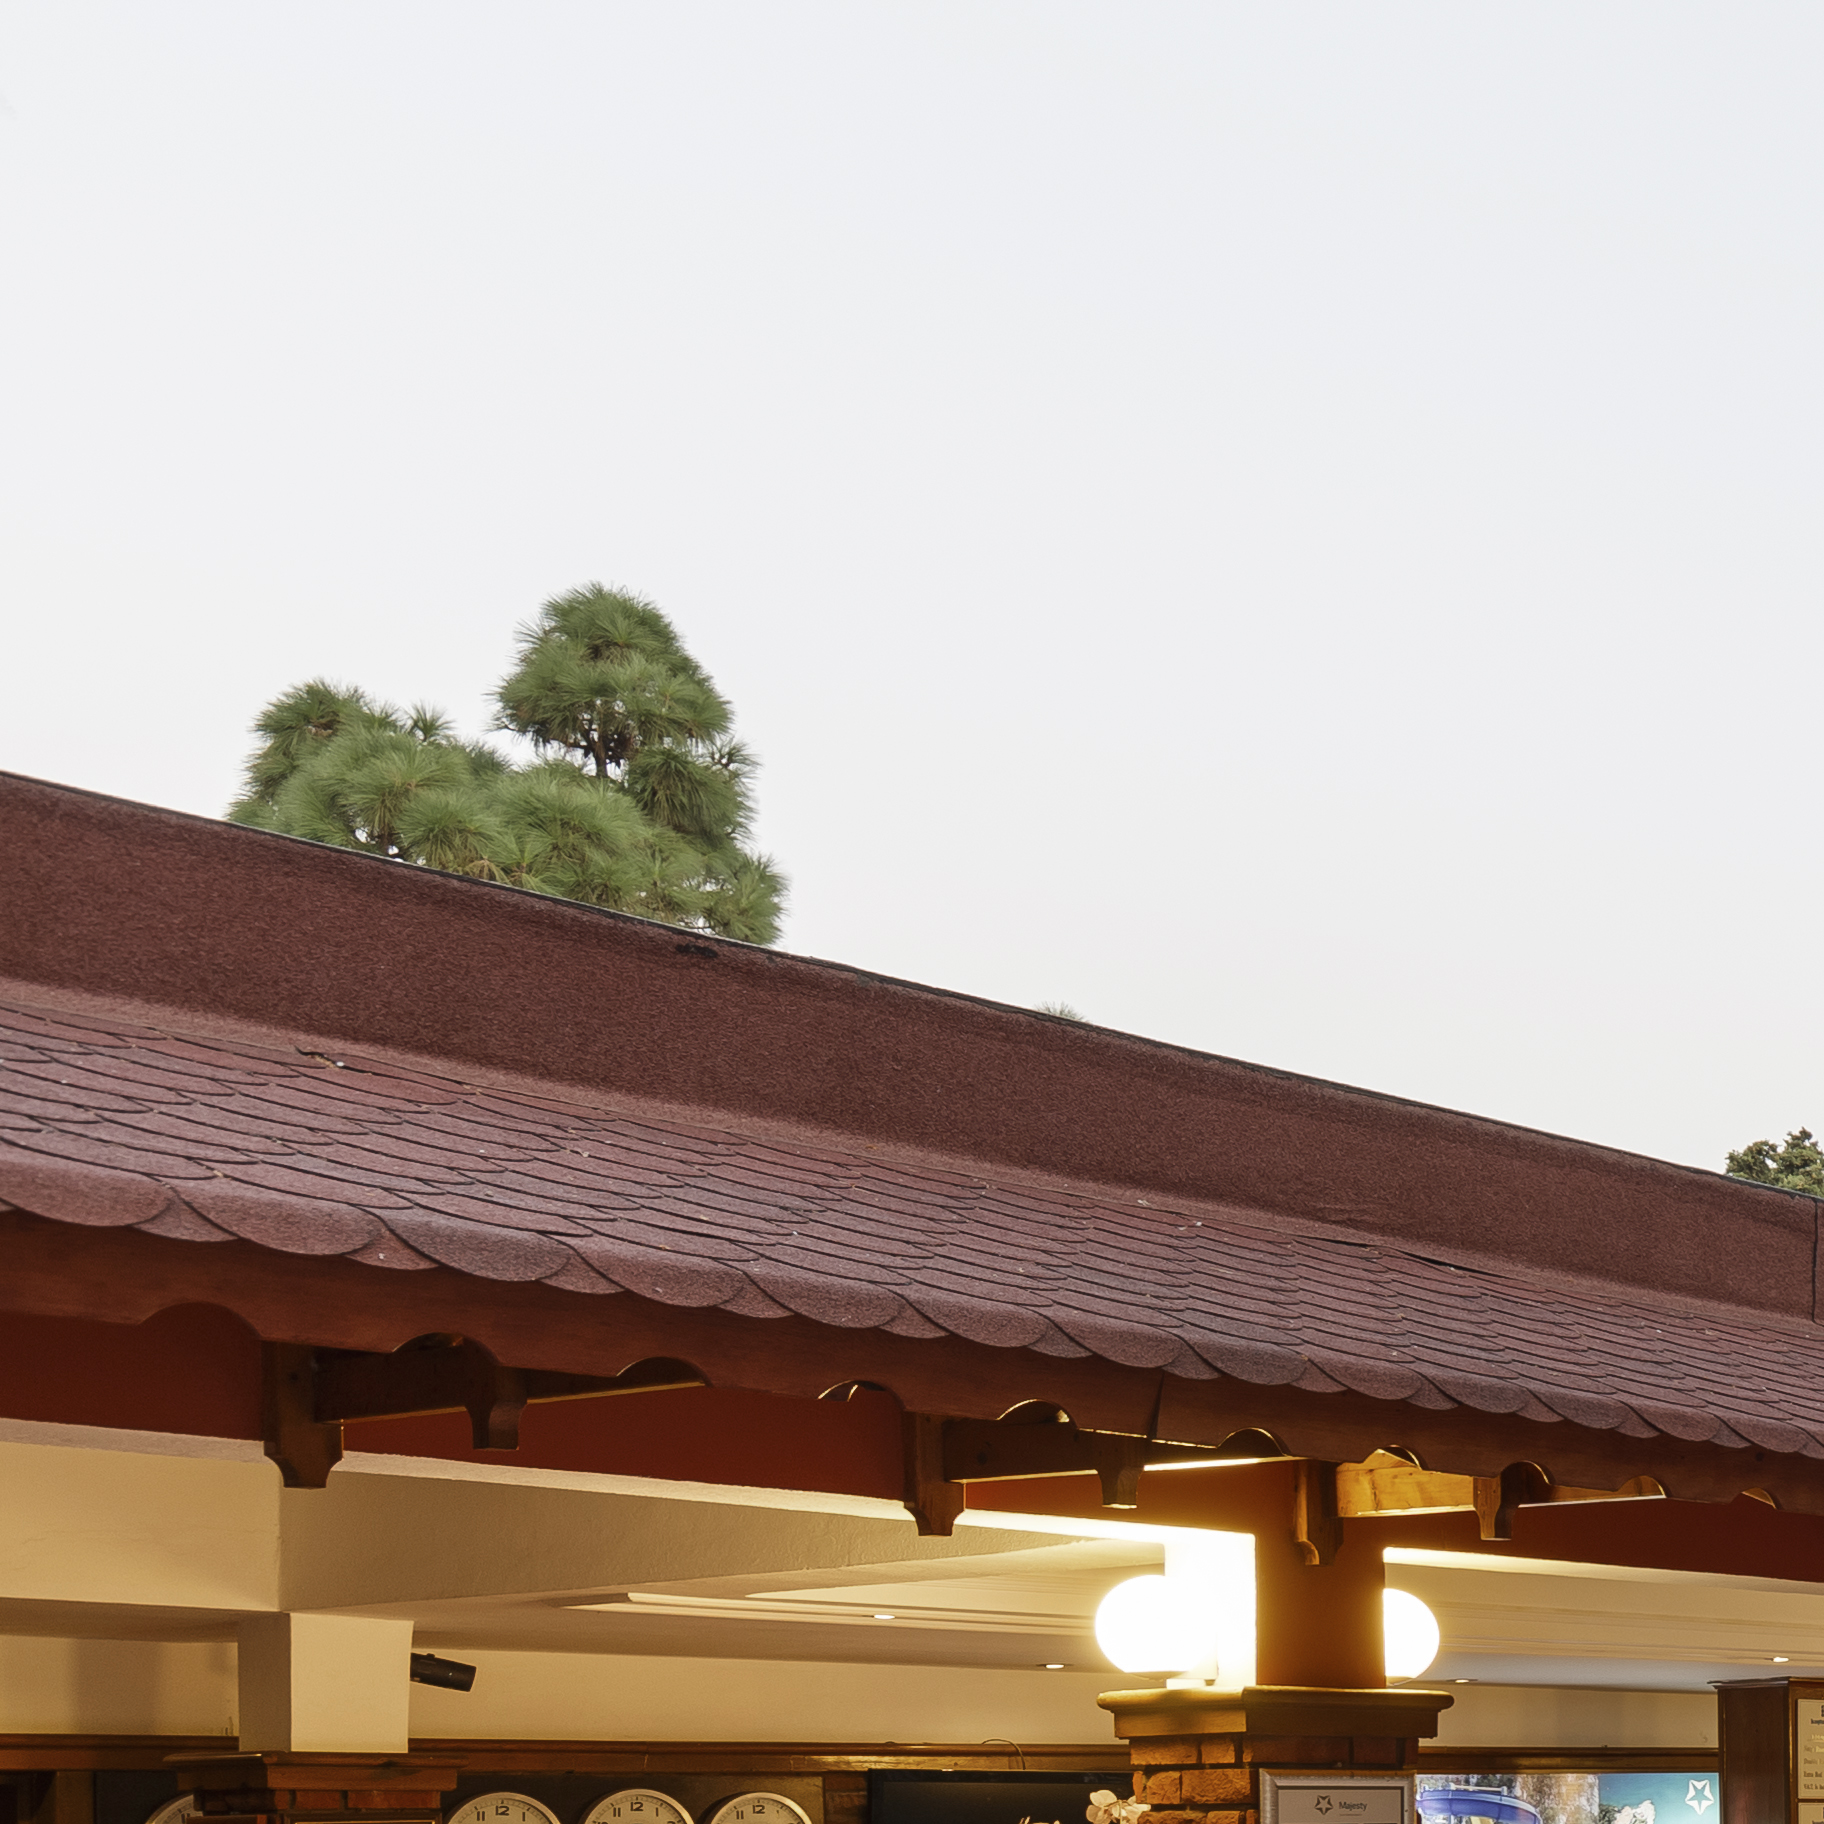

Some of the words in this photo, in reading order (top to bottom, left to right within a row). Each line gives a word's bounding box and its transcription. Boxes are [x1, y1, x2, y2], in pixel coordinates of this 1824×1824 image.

[495, 1806, 510, 1816] 12
[613, 1807, 621, 1817] 11
[630, 1802, 644, 1812] 12
[752, 1804, 765, 1814] 12
[1339, 1802, 1368, 1812] Majesty
[476, 1811, 486, 1822] 11
[736, 1810, 744, 1820] 11
